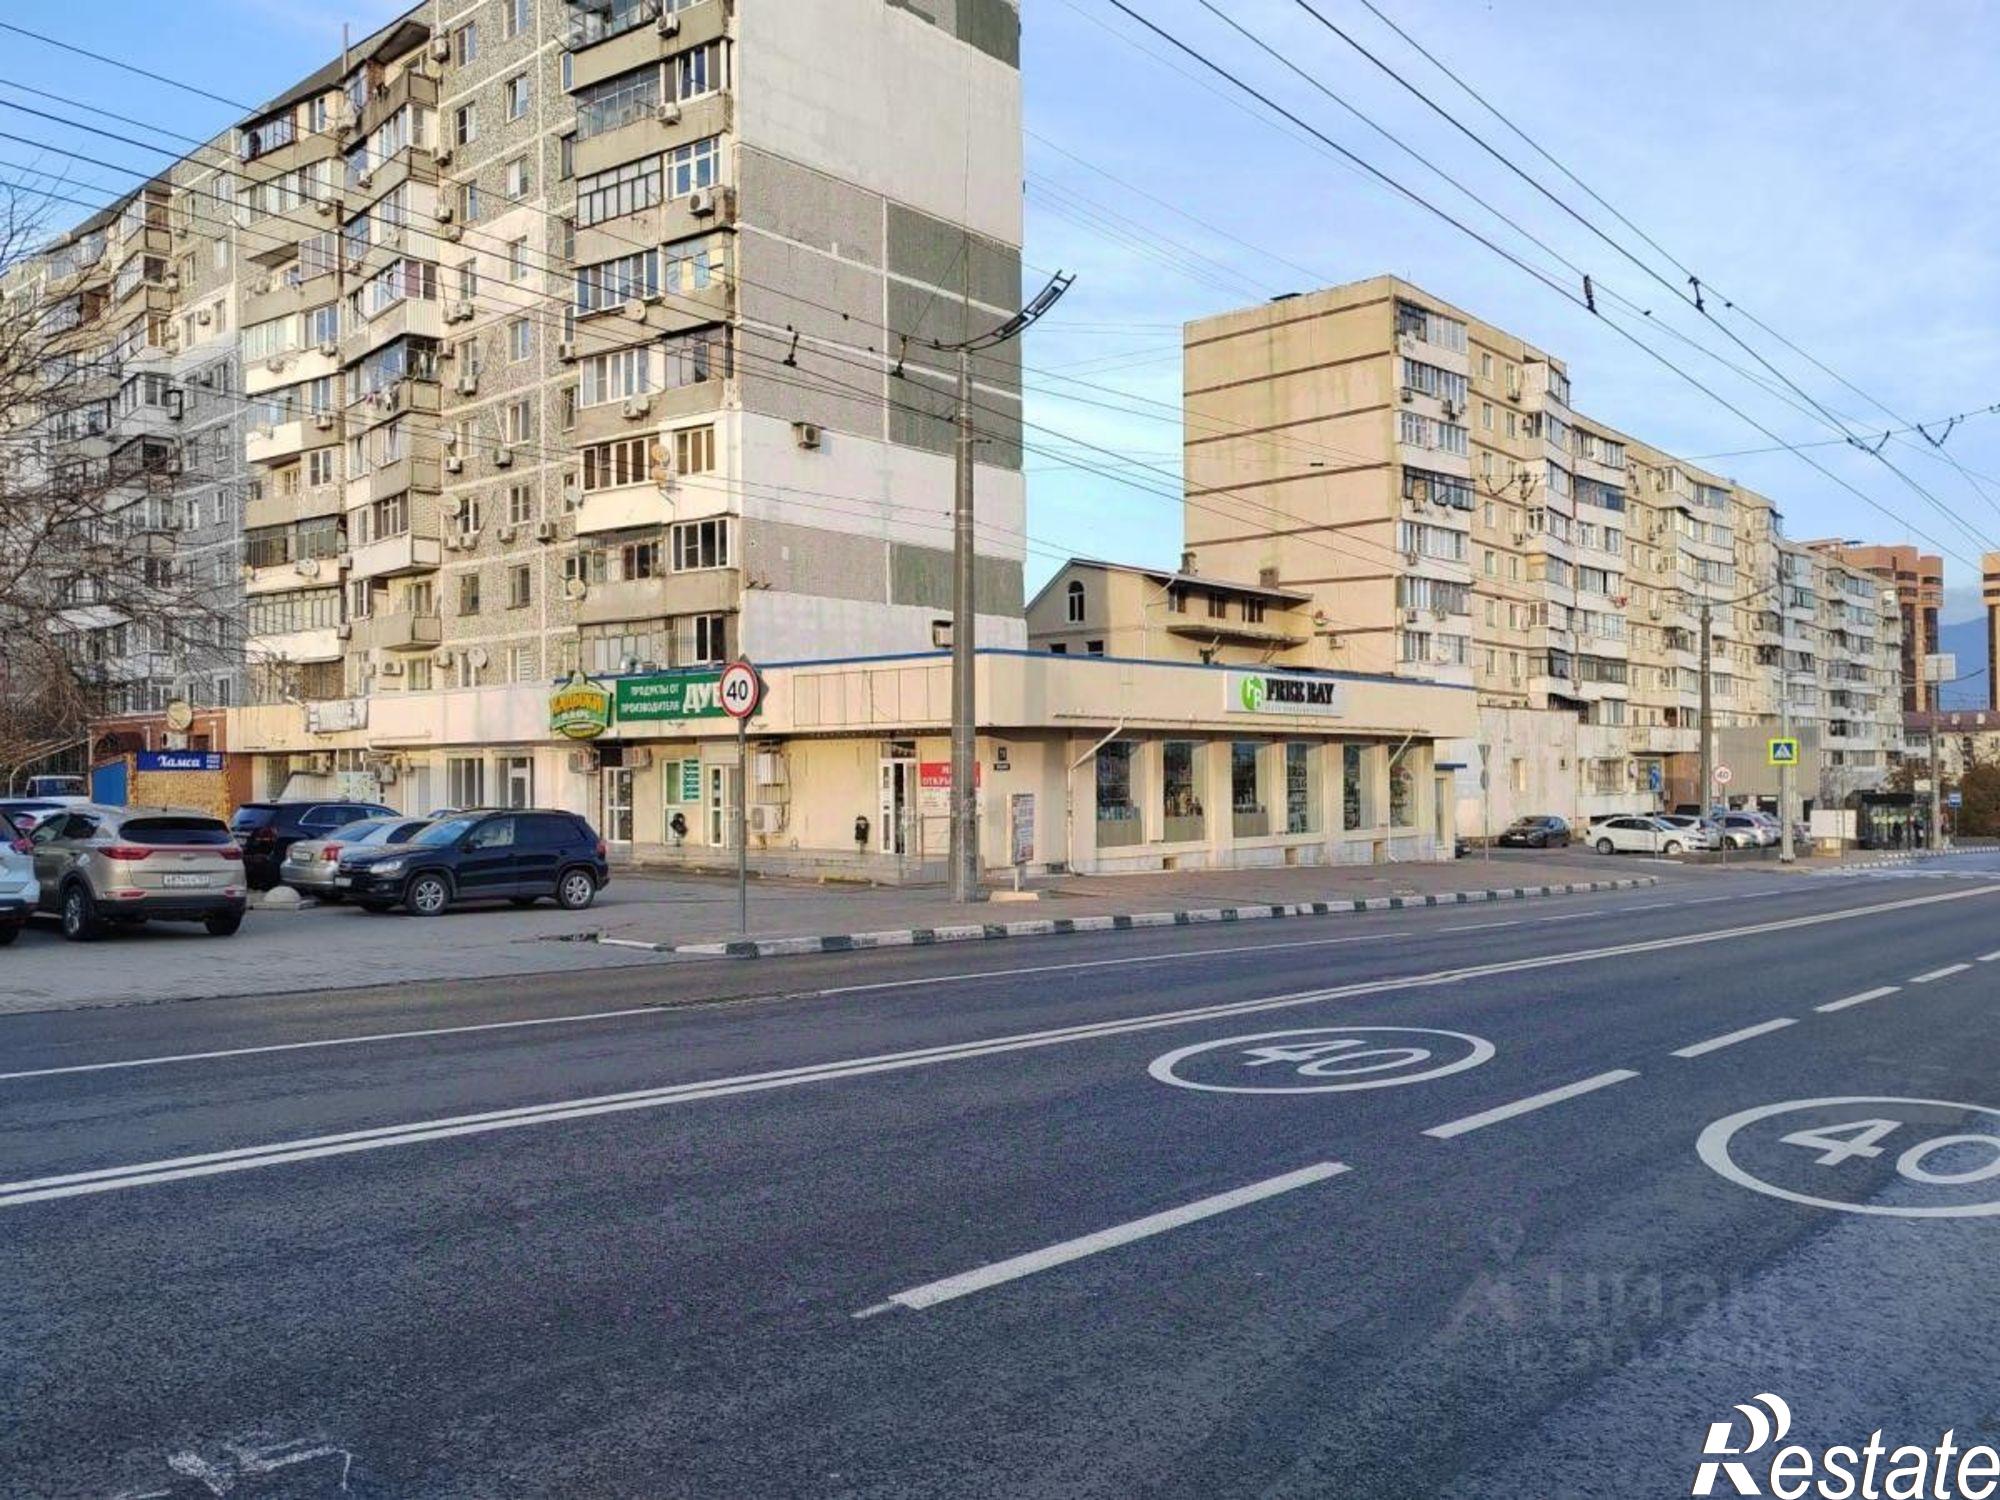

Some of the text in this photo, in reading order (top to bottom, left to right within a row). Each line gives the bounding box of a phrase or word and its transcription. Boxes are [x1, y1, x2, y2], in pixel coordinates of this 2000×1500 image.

[726, 680, 748, 701] 40
[1265, 678, 1305, 702] FREE
[157, 755, 200, 767] Хамса
[1716, 770, 1729, 780] 40
[1241, 1038, 1431, 1076] 40
[1779, 1118, 2000, 1184] 40
